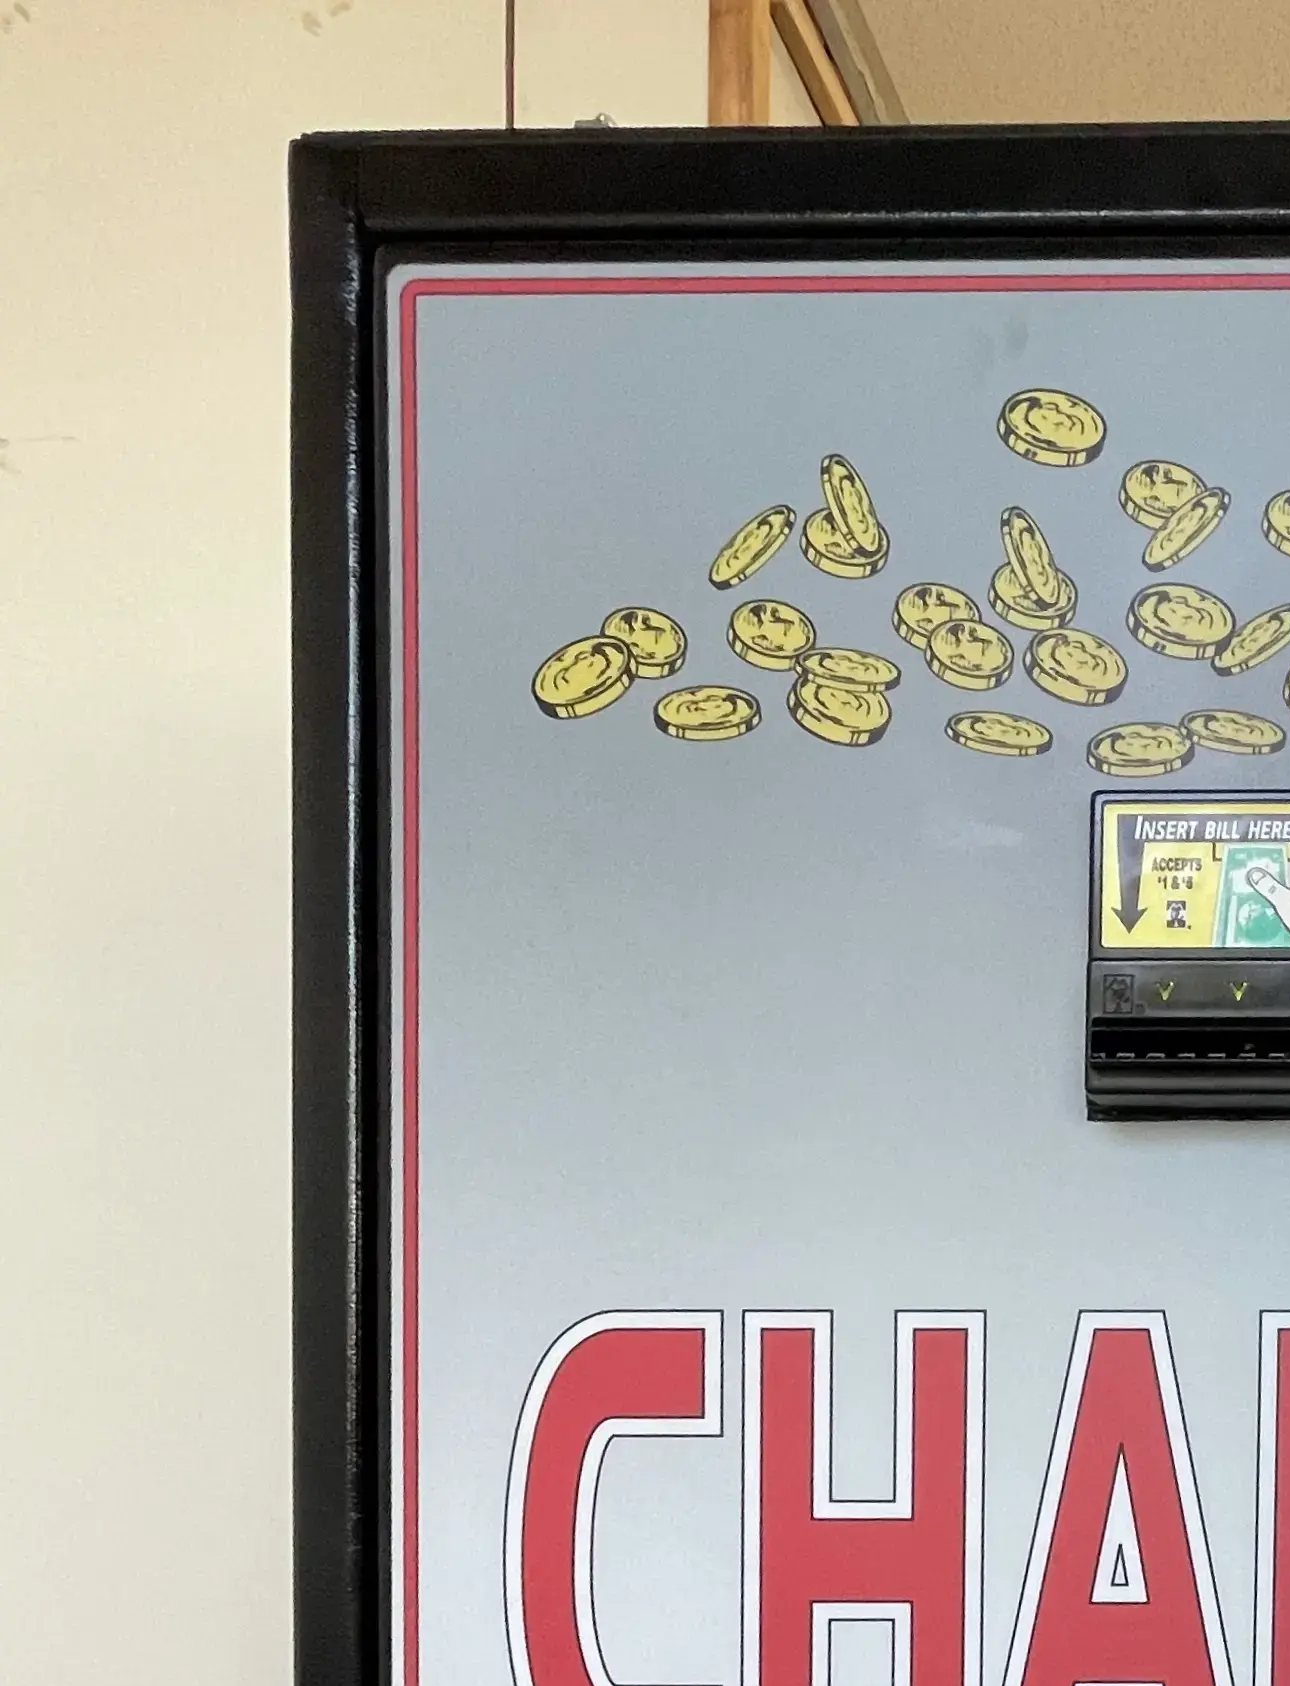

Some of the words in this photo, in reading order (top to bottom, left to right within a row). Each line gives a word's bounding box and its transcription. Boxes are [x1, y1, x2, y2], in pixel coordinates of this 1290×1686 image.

[1134, 815, 1198, 841] INSERT
[1204, 820, 1241, 840] BILL
[1151, 856, 1203, 872] ACCEPTS
